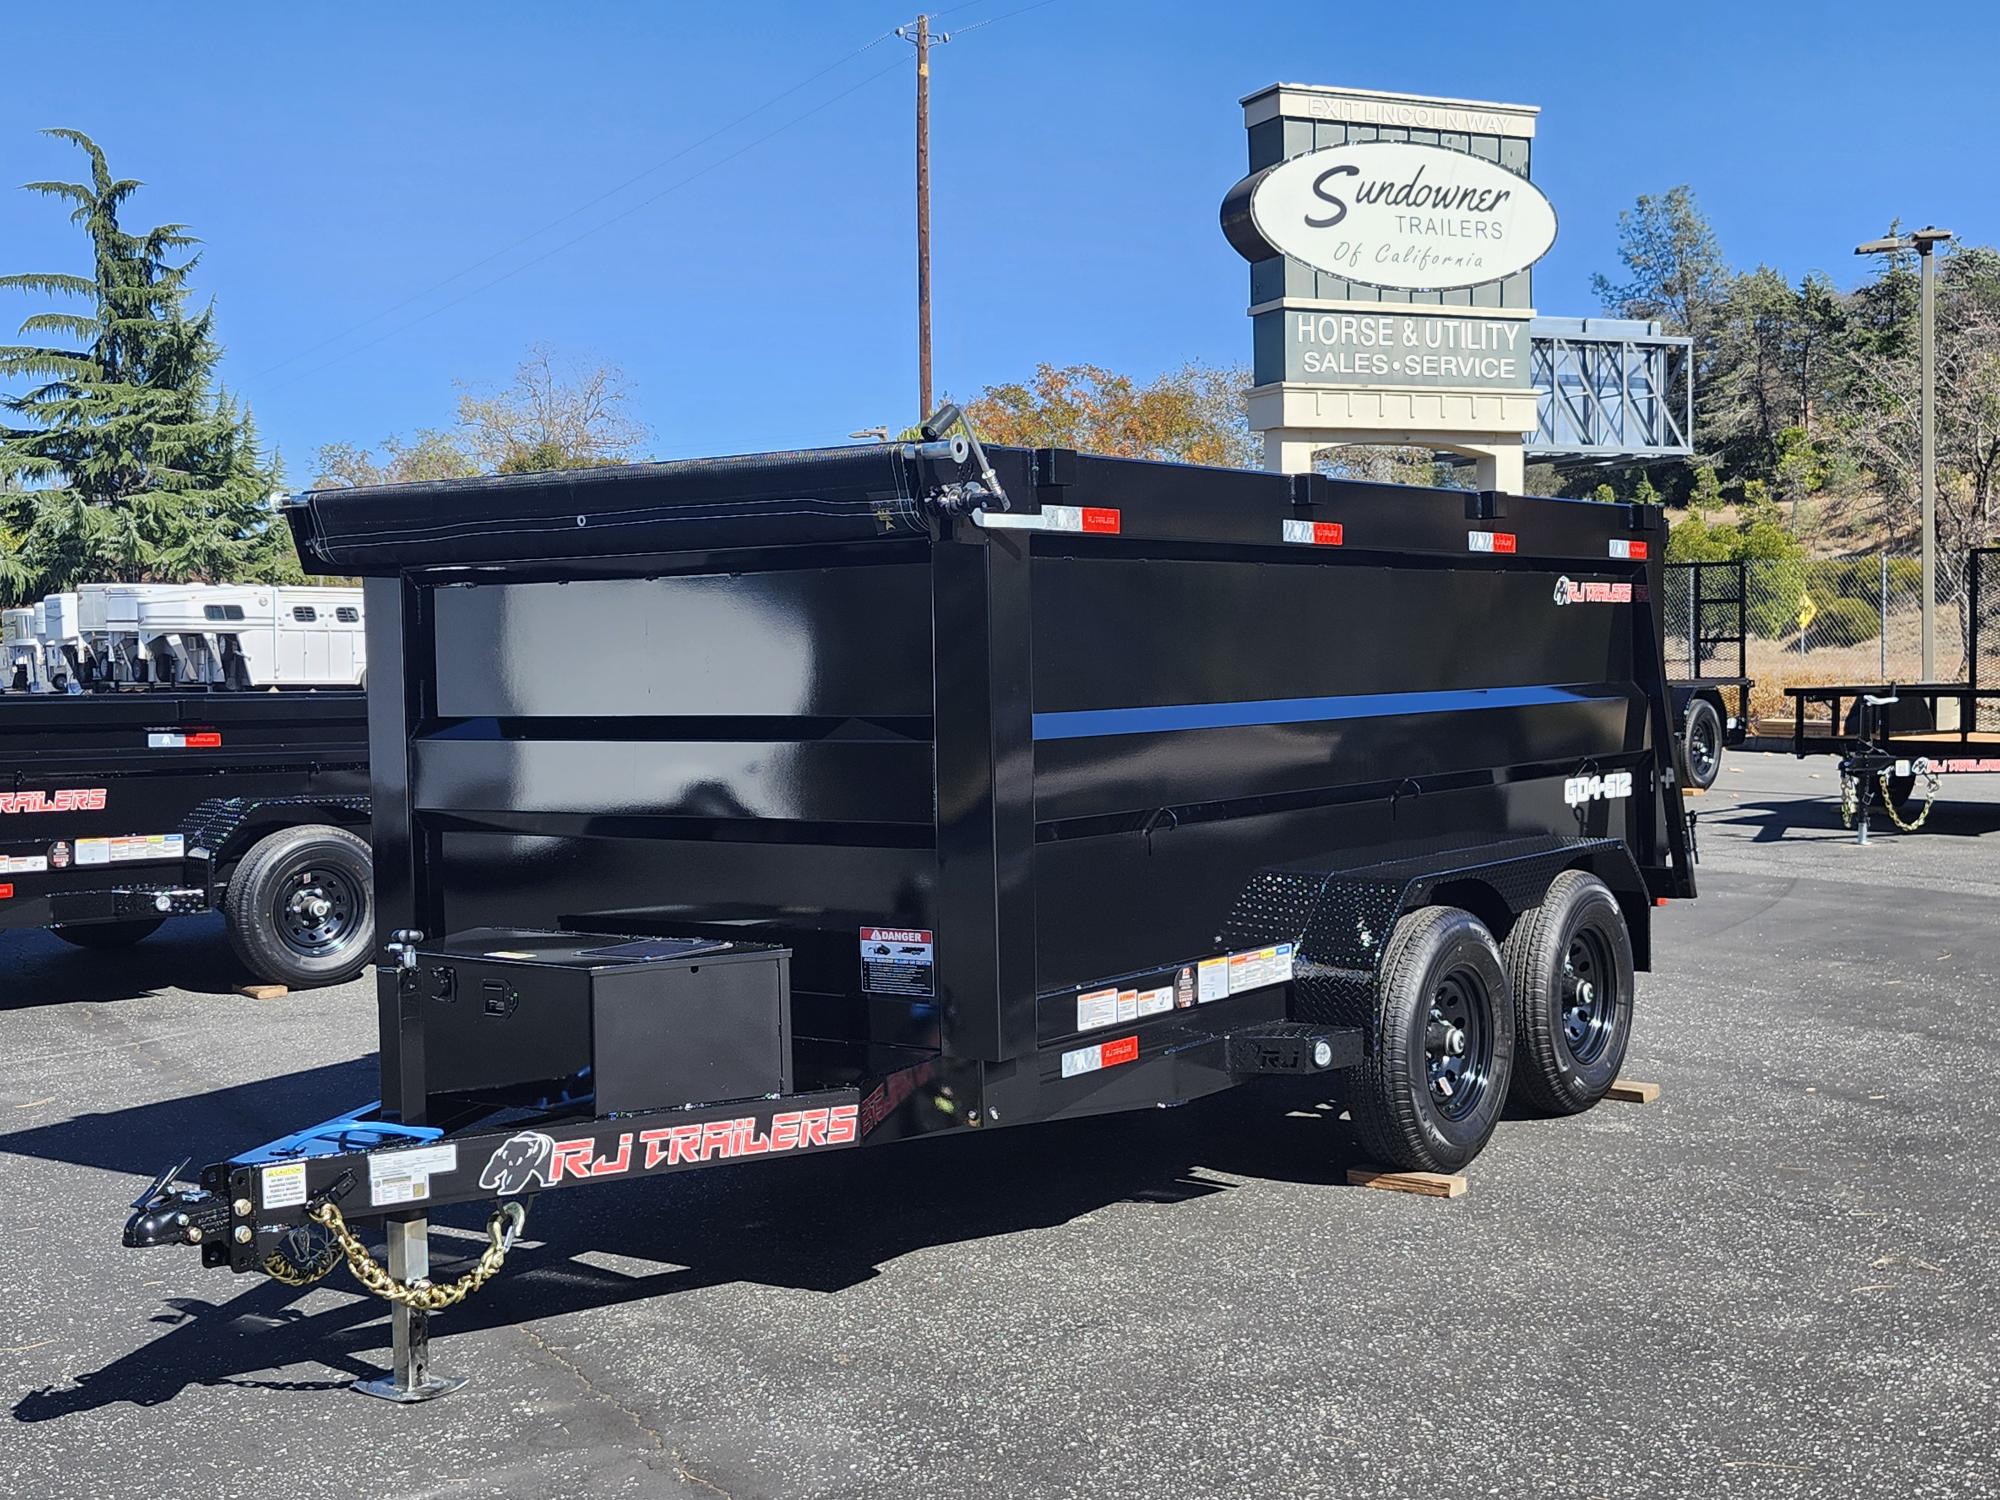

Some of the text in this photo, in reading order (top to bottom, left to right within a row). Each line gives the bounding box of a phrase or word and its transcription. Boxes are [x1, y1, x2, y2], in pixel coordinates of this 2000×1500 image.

[1308, 98, 1512, 135] EXIT LINCOLN WAY
[1304, 164, 1511, 229] Sundowner
[1395, 215, 1503, 240] TRAILERS
[1333, 241, 1483, 271] Of California
[1297, 314, 1520, 351] HORSE & UTILITY
[1303, 351, 1517, 379] SALES SERVICE
[881, 931, 922, 942] DANGER
[548, 1133, 633, 1182] RJ
[639, 1104, 859, 1170] TRAILERS
